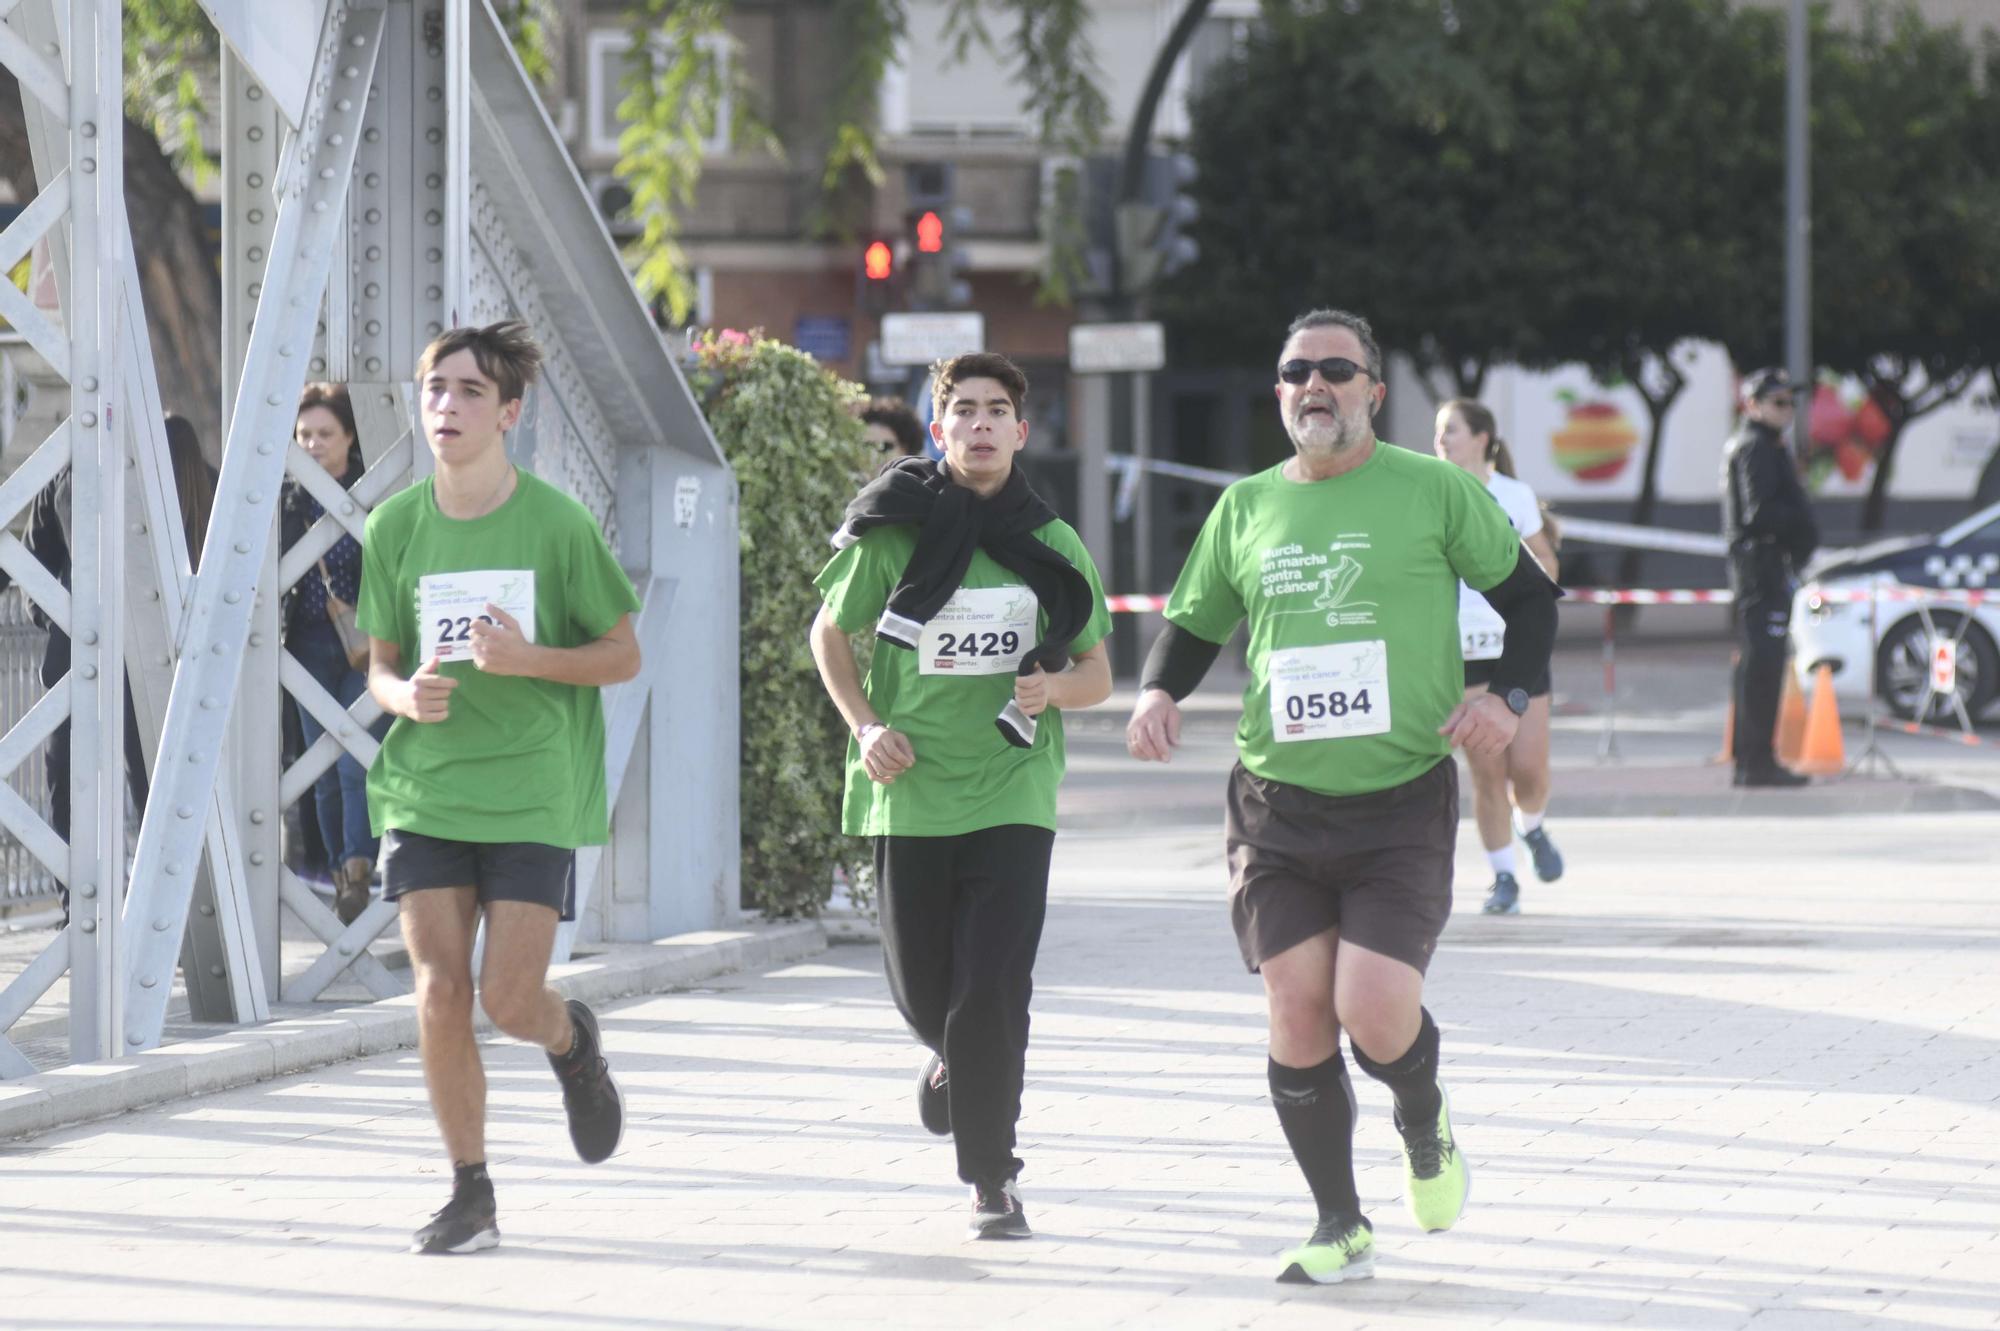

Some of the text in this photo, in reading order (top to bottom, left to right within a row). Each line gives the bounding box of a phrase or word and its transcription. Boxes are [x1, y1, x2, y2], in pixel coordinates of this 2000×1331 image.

[1261, 543, 1303, 560] Murcia
[1261, 553, 1327, 572] en marcha
[1261, 569, 1302, 585] contra
[1263, 580, 1319, 598] el cáncer
[957, 613, 965, 621] el
[966, 612, 994, 621] cáncer
[437, 615, 501, 643] 22
[937, 631, 1019, 656] 2429
[1286, 689, 1372, 721] 0584
